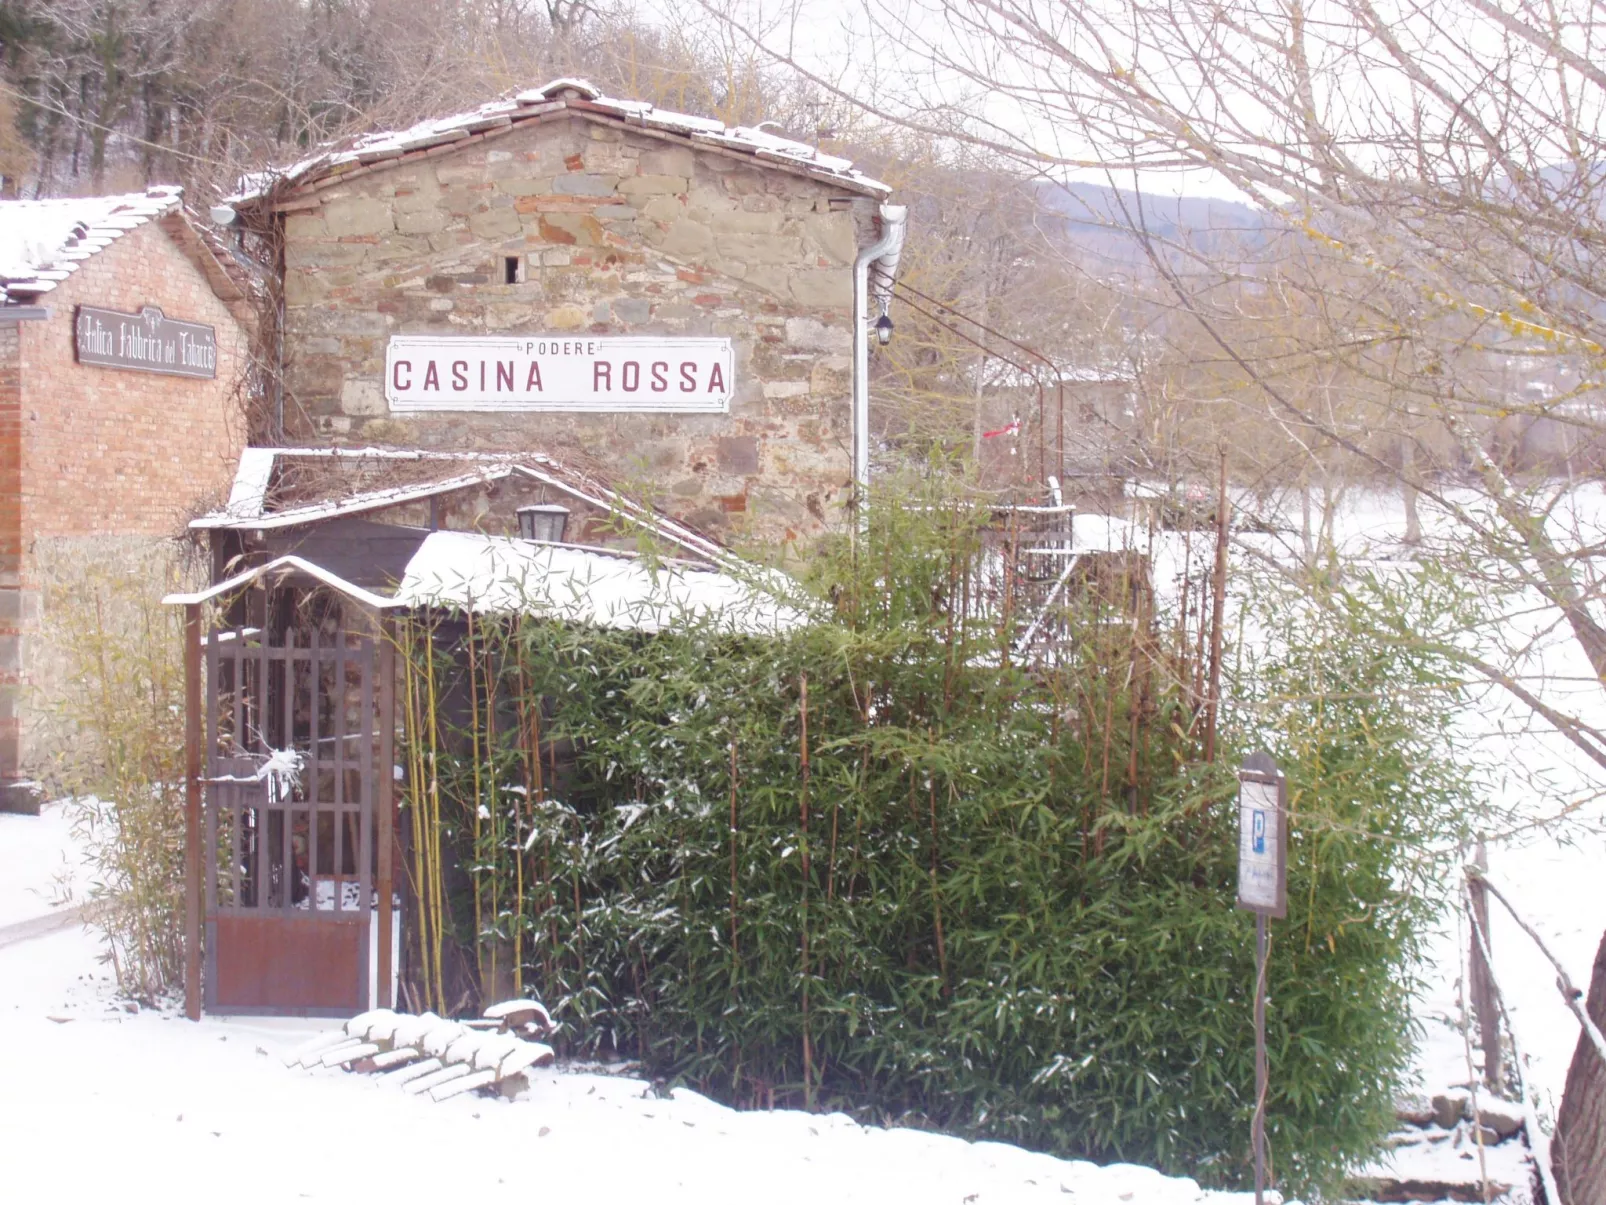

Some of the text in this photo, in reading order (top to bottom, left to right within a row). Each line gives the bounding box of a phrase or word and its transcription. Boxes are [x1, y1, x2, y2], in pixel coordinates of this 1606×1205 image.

[84, 315, 113, 356] Antica
[119, 322, 162, 363] Fabbrica
[165, 339, 176, 364] del
[526, 341, 596, 356] PODERE
[392, 360, 726, 394] CASINA ROSSA
